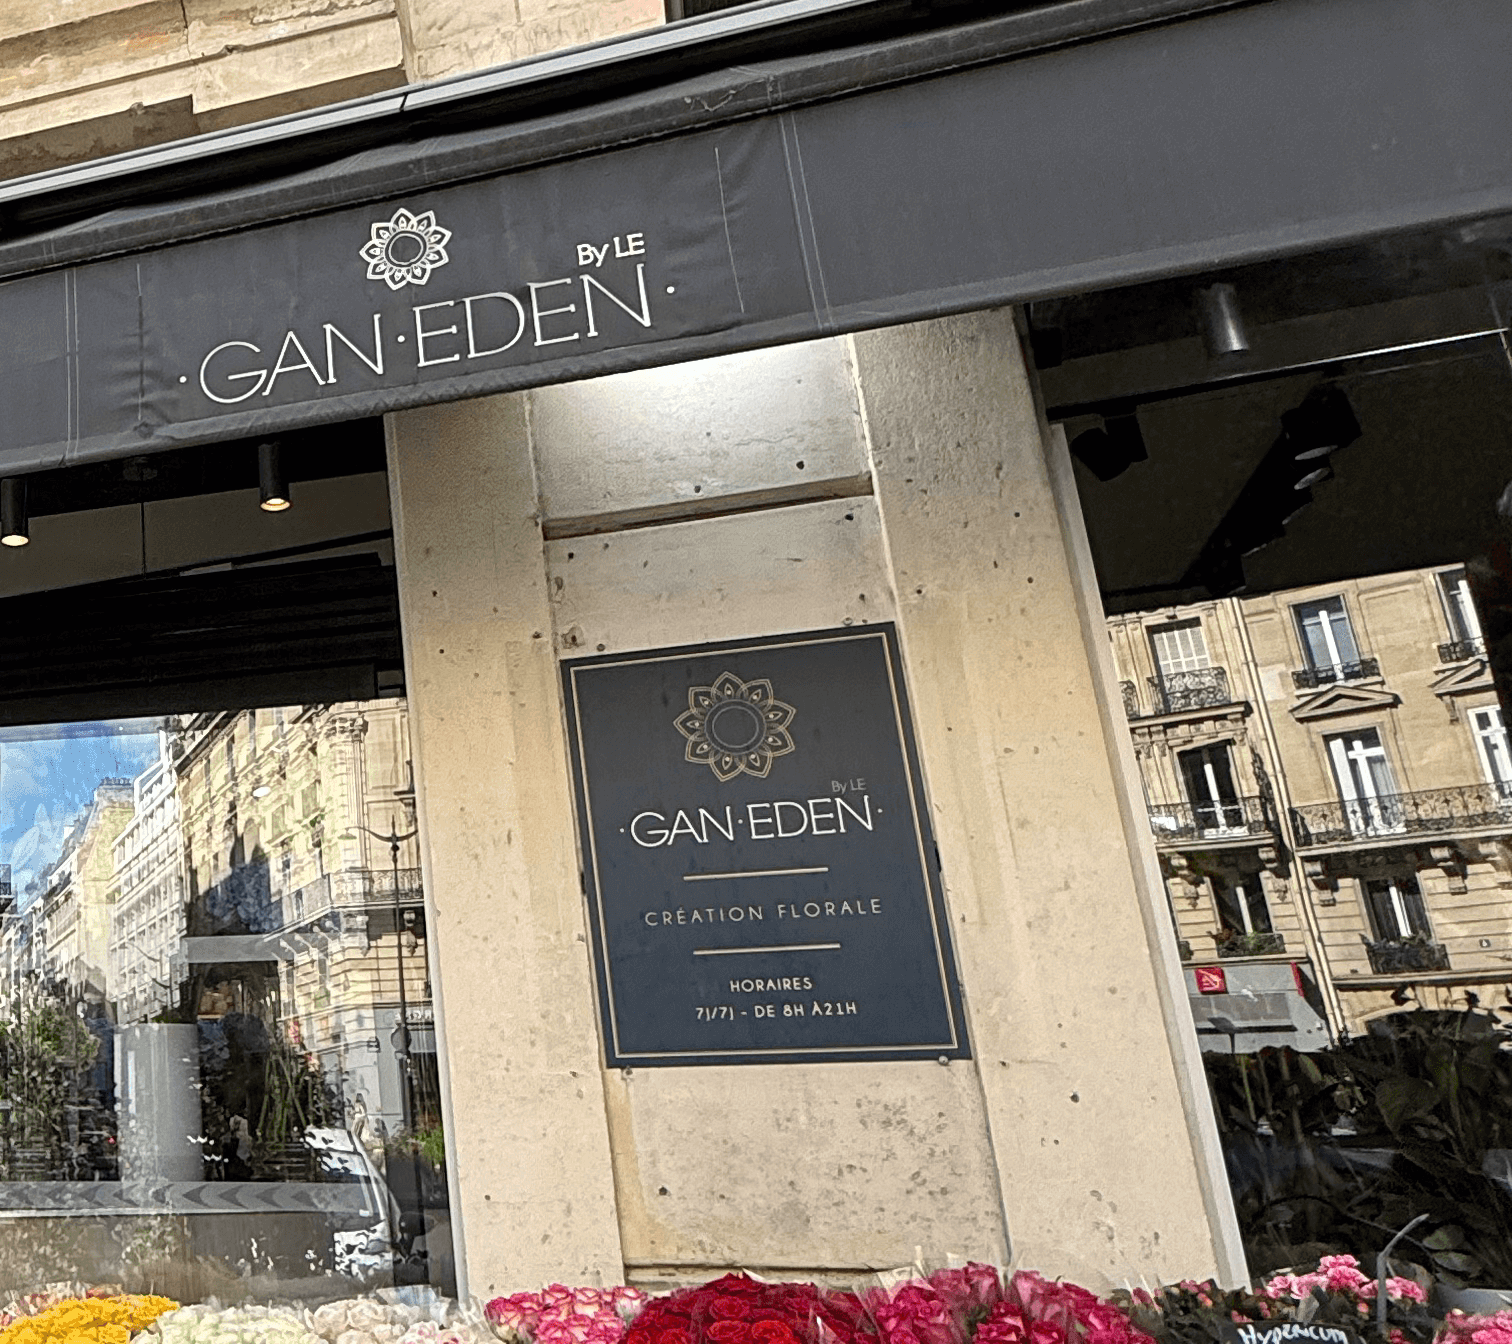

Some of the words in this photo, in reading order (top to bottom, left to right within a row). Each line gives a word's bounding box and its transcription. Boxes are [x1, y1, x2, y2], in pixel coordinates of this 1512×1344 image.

[576, 243, 608, 268] By
[613, 233, 646, 258] LE
[831, 779, 847, 795] By
[849, 777, 867, 792] LE
[645, 905, 764, 927] CRÉATION
[778, 898, 883, 918] FLORALE
[729, 977, 814, 993] HORAIRES
[754, 1004, 776, 1019] DE
[783, 1003, 805, 1017] 8H
